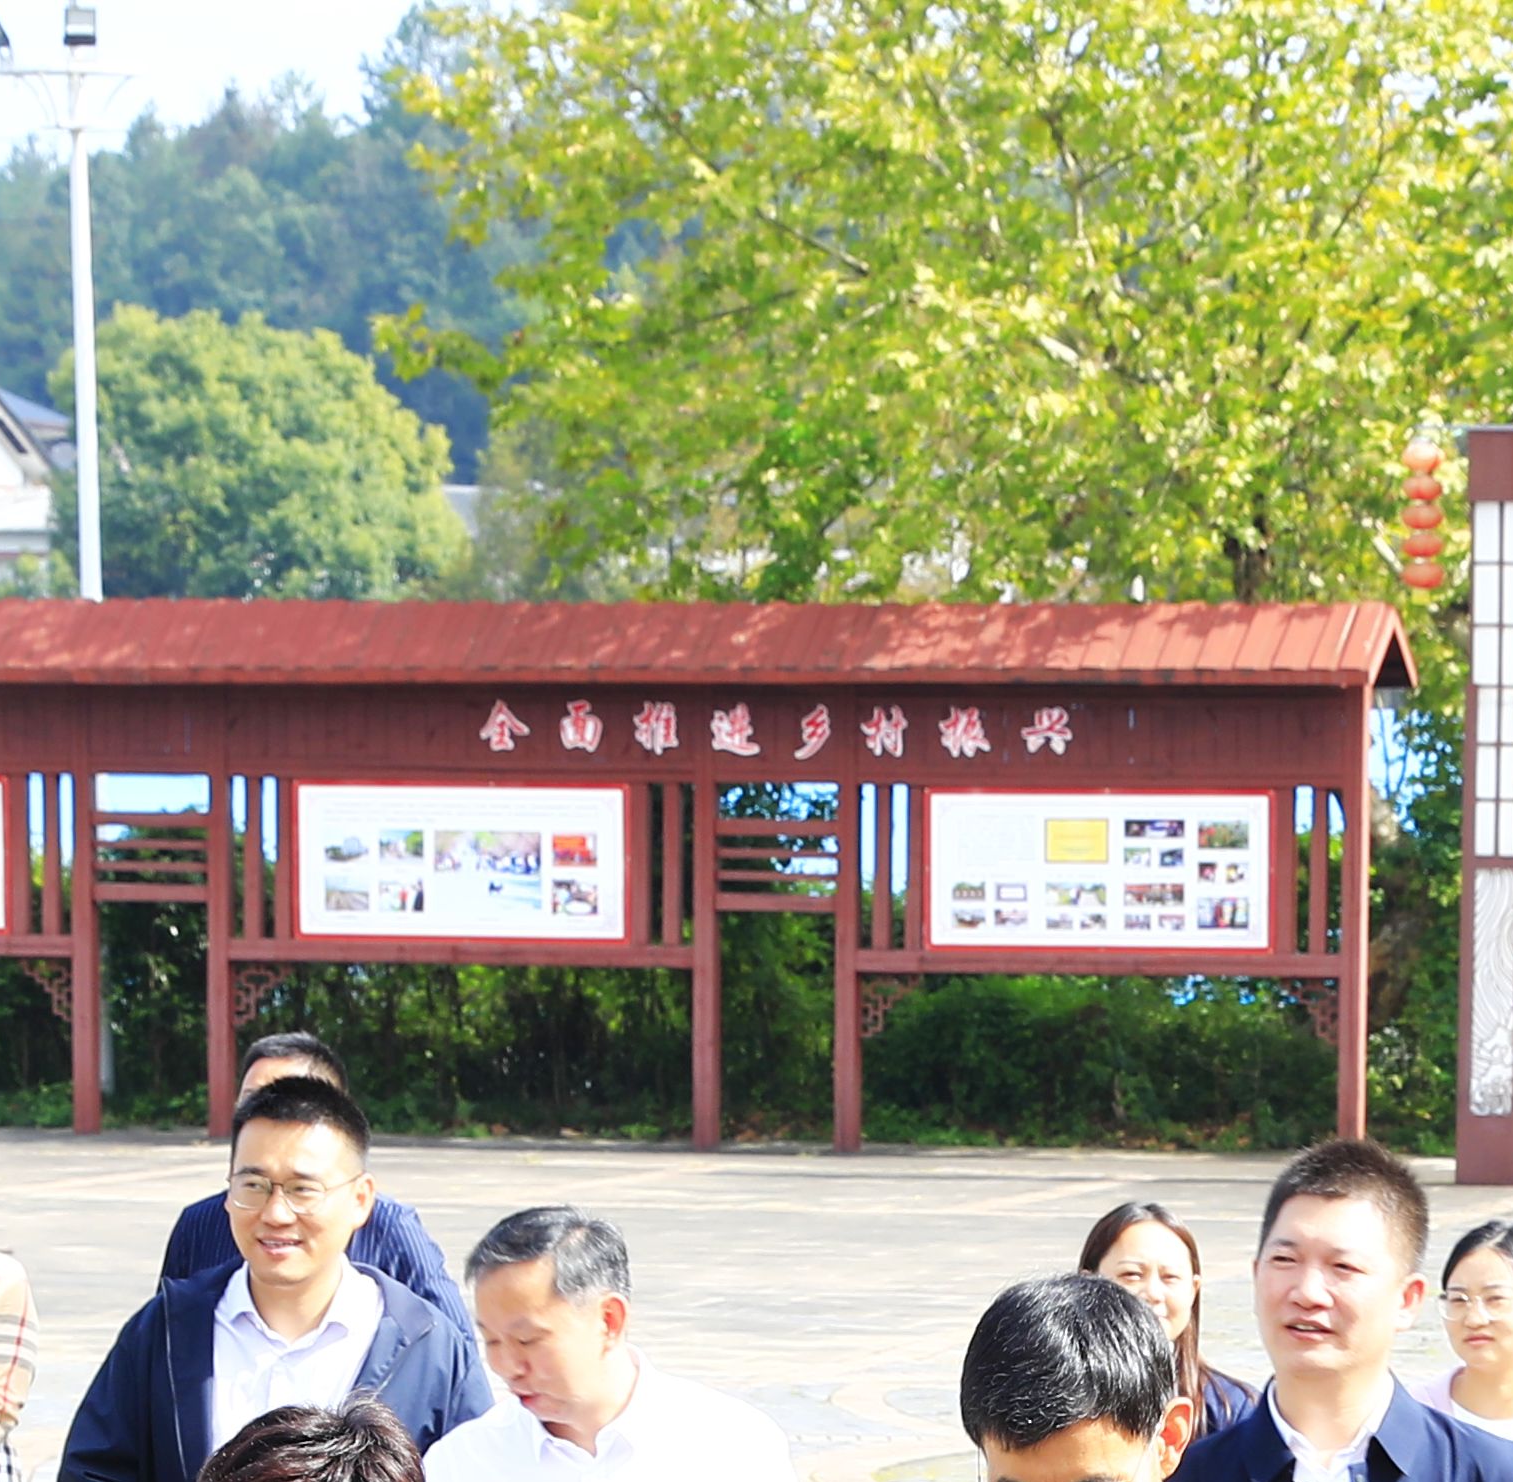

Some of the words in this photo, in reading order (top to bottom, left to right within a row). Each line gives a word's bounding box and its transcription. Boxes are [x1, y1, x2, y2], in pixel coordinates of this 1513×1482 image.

[480, 700, 1073, 760] 全面推进乡村振兴
